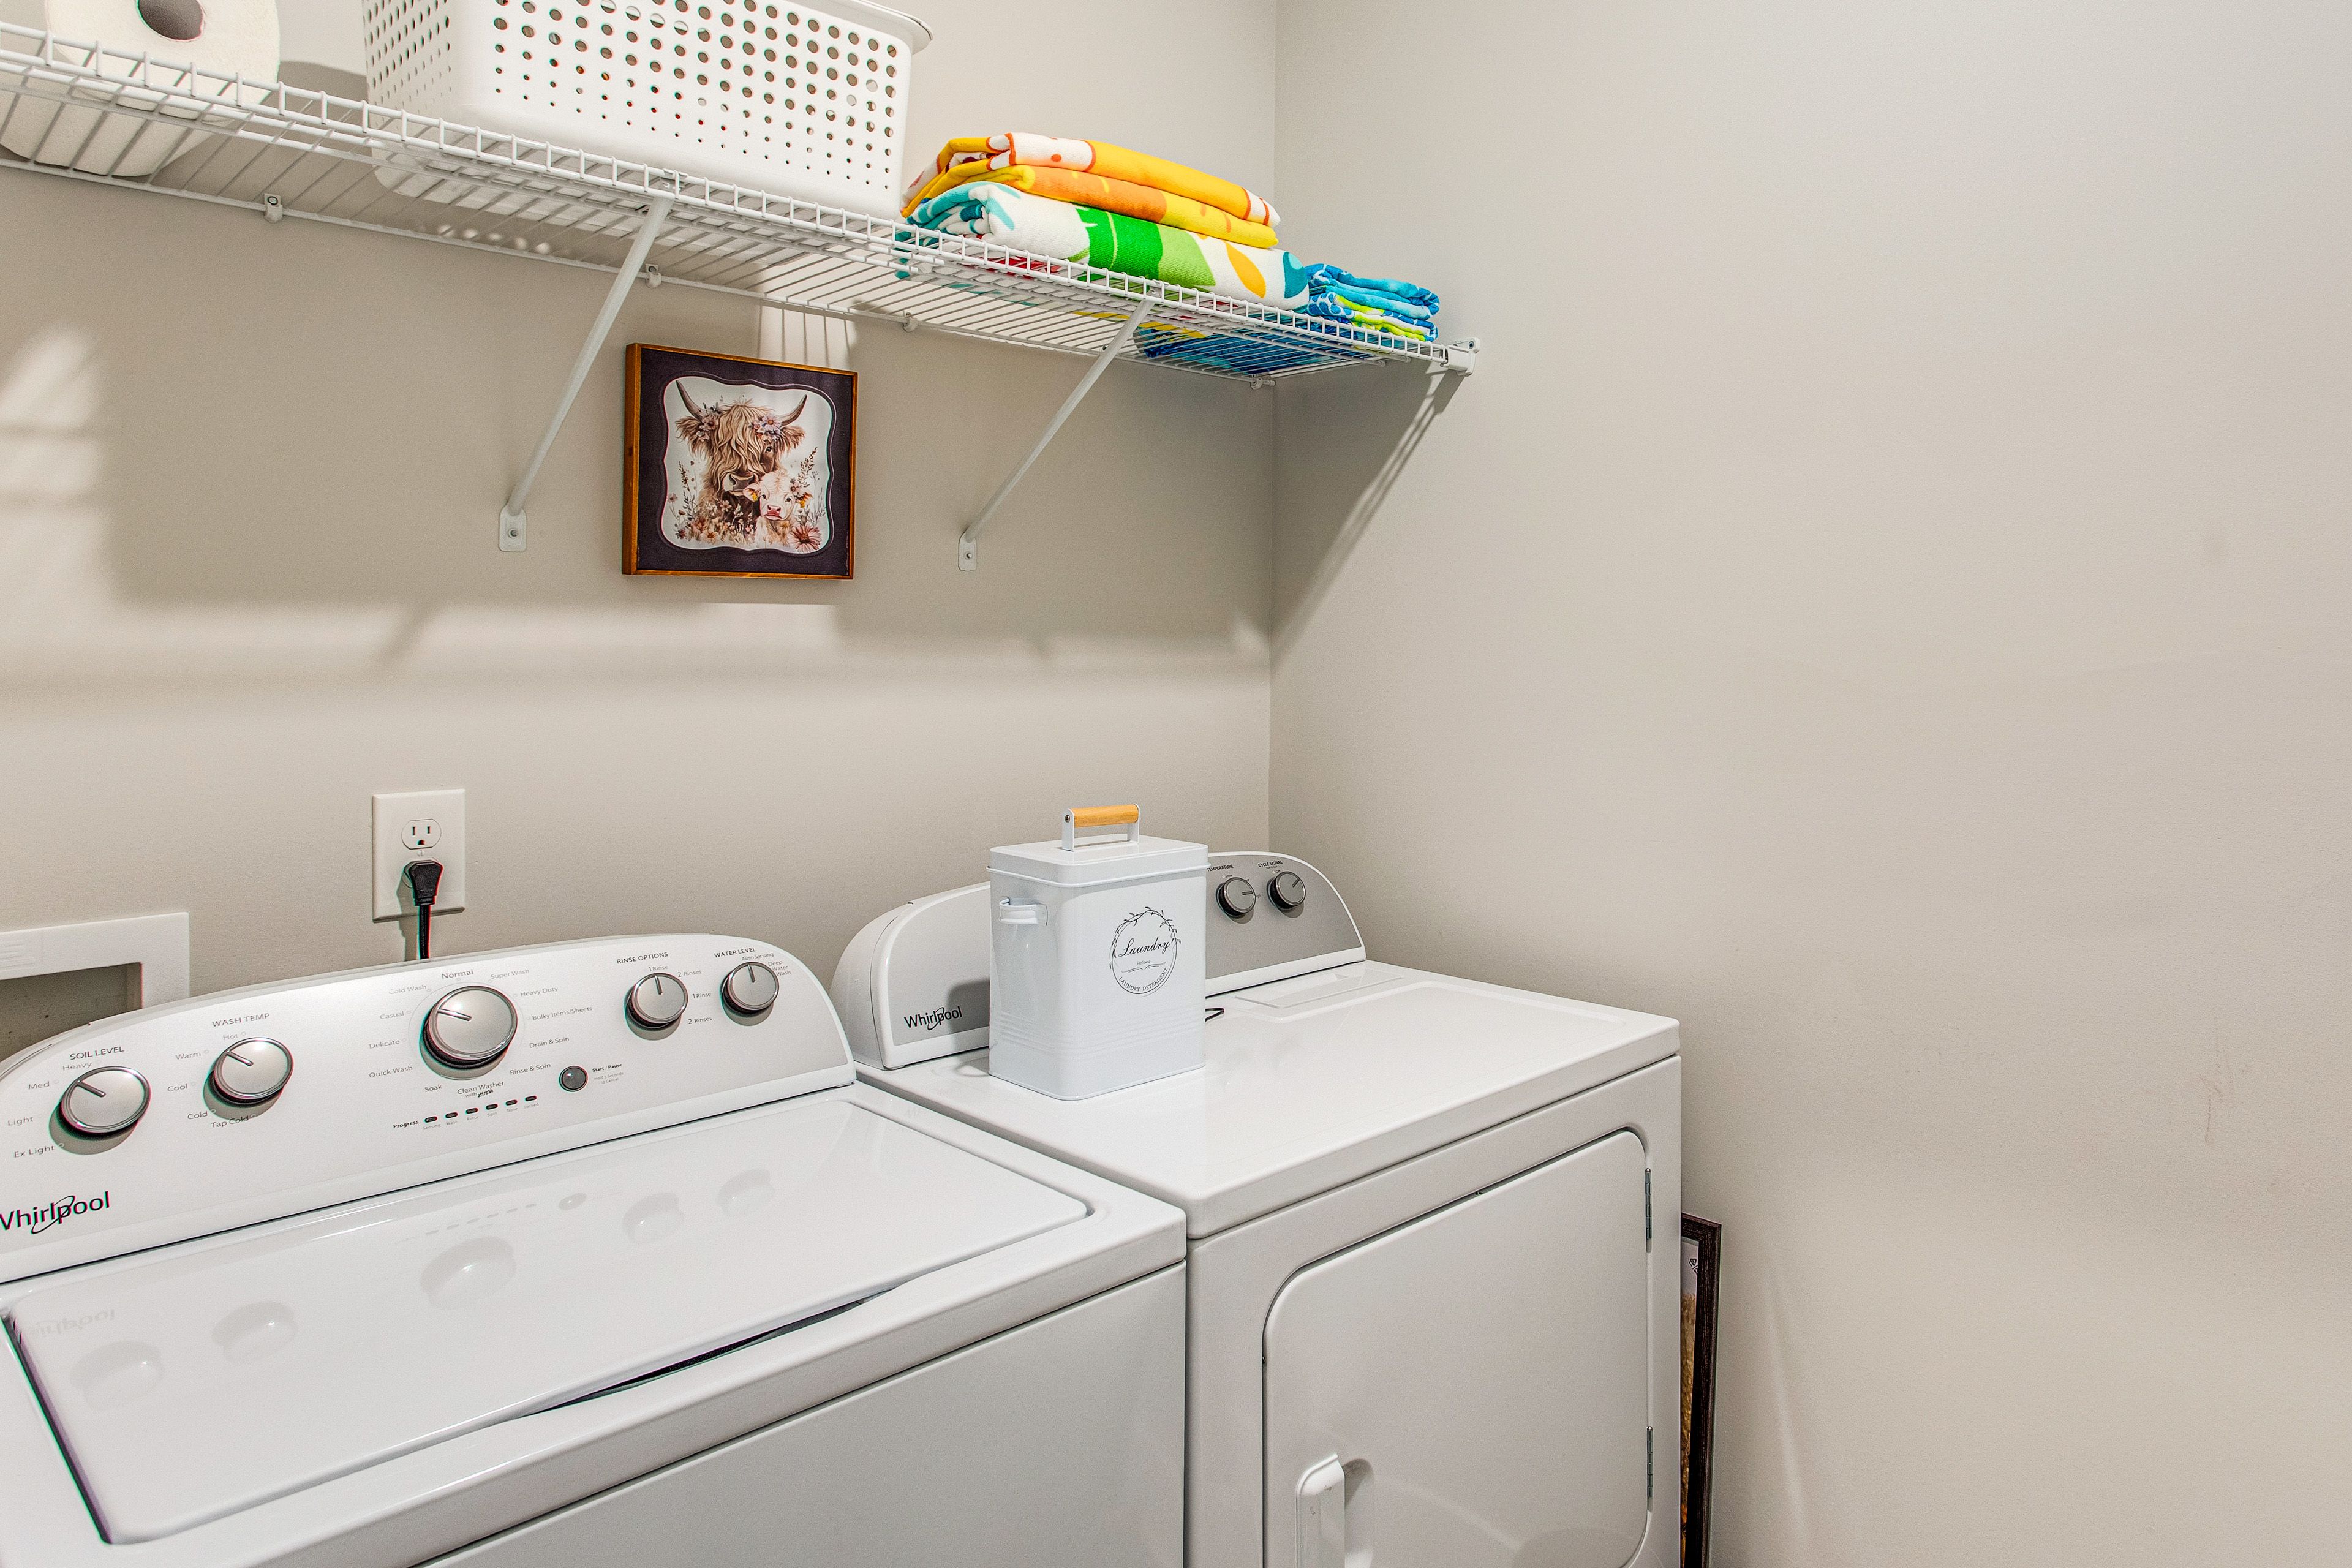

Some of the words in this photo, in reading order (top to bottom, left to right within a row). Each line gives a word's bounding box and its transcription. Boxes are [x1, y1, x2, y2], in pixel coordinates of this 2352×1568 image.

[1118, 936, 1170, 957] Laundry
[638, 951, 668, 961] OPTIONS
[442, 968, 473, 979] Normal
[1118, 976, 1140, 992] LAUNDRY
[1142, 967, 1169, 991] DETERGENT
[380, 1011, 404, 1020] Casual
[551, 1006, 593, 1018] Items/Sheets
[212, 1017, 241, 1027] WASH
[244, 1012, 270, 1022] TEMP
[904, 1006, 962, 1030] Whirlpool
[369, 1039, 400, 1049] Delicate
[70, 1051, 93, 1060] SOIL
[95, 1046, 125, 1057] LEVEL
[62, 1061, 92, 1071] Heavy
[536, 1063, 551, 1071] Spin
[369, 1069, 391, 1078] Quick
[28, 1081, 50, 1090] Med
[167, 1083, 188, 1092] Cool
[478, 1081, 505, 1090] Washer
[187, 1110, 208, 1120] Cold
[229, 1115, 249, 1125] Cold
[8, 1117, 34, 1126] Light
[393, 1120, 419, 1129] Progress
[29, 1145, 55, 1155] Light
